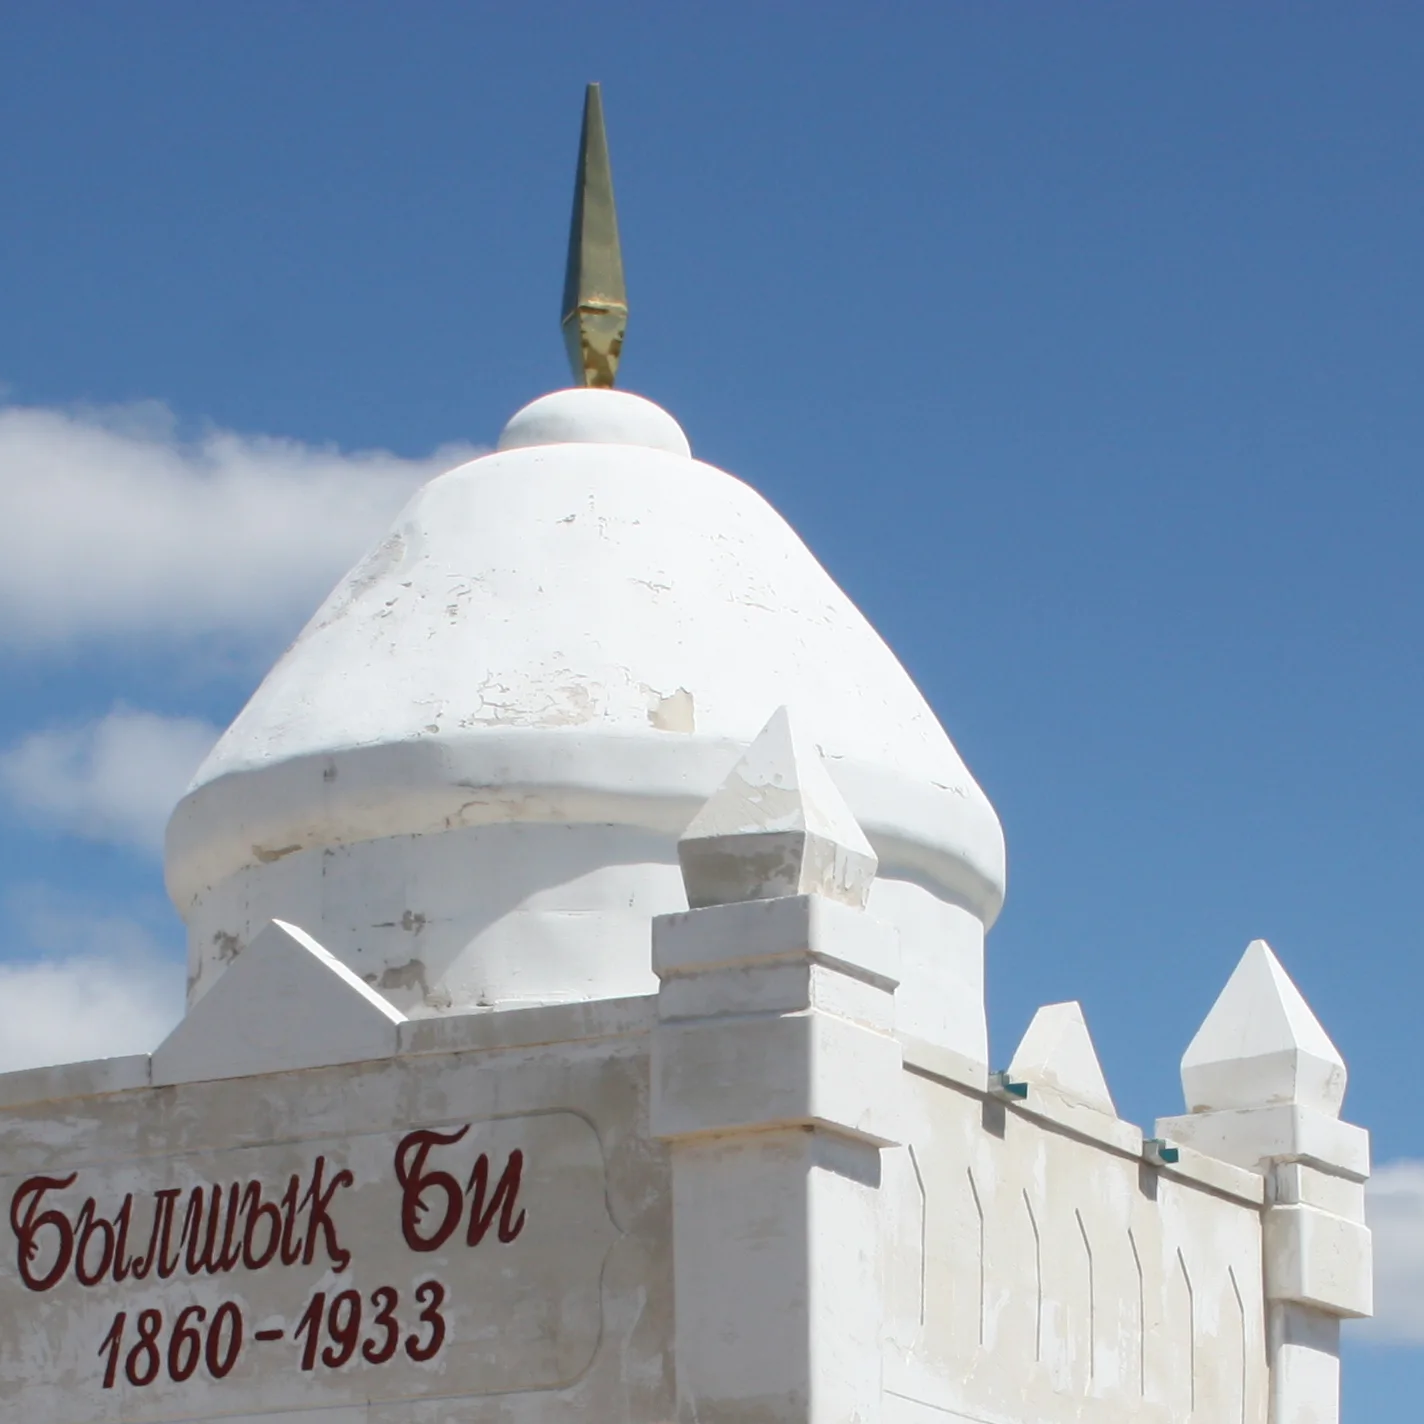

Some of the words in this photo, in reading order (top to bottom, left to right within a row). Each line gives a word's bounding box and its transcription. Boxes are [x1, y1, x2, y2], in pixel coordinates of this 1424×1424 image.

[10, 1156, 353, 1291] Былшық
[395, 1124, 527, 1252] Би
[98, 1281, 446, 1388] 1860-1933
